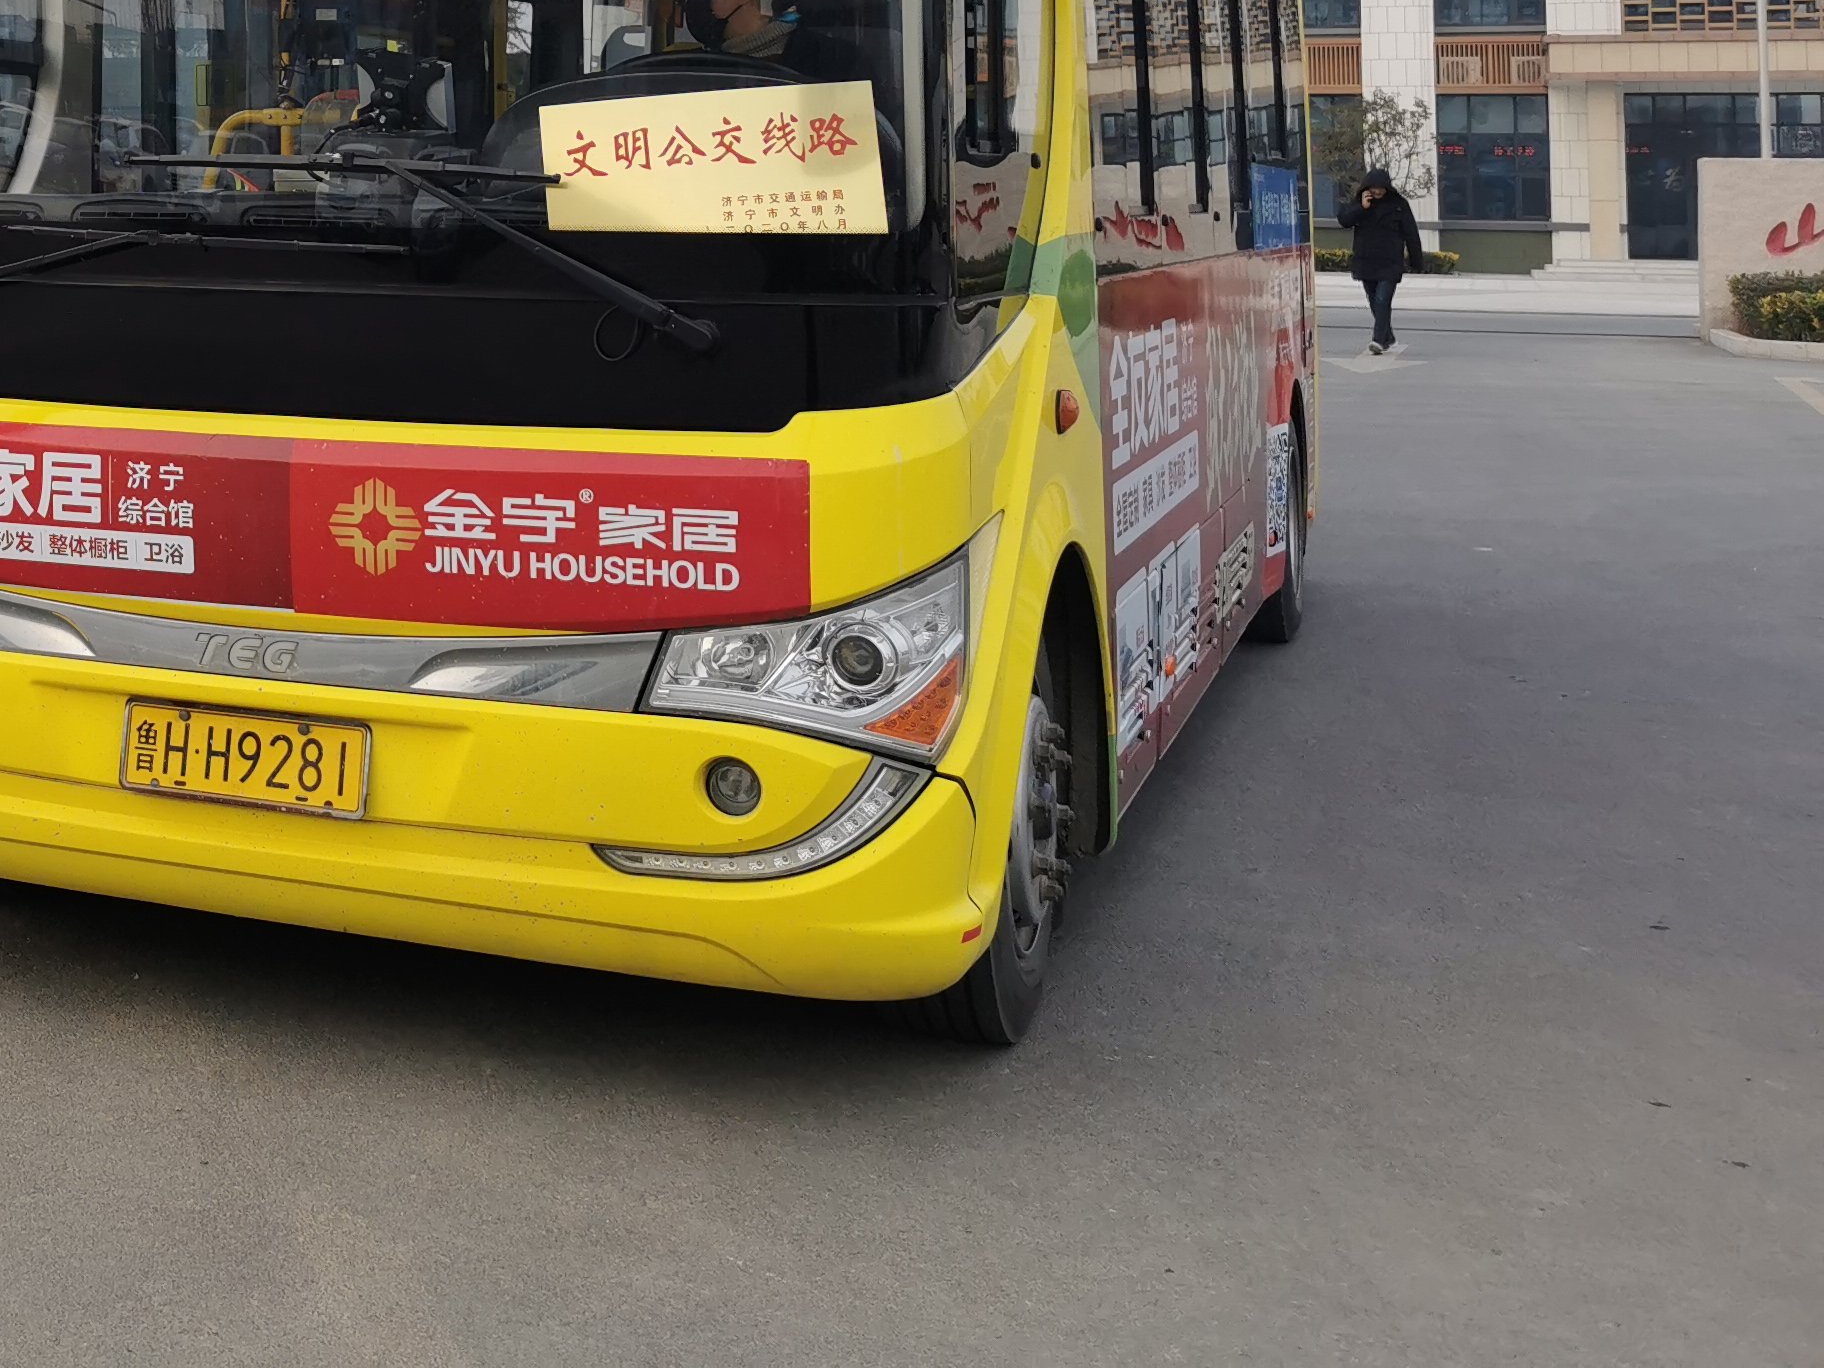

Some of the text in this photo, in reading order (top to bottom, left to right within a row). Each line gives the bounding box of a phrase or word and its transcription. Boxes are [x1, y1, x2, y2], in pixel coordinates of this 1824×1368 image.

[563, 111, 859, 177] 文明公交线路
[721, 189, 844, 207] 济宁市交通运输局
[722, 204, 846, 222] 济宁市文明办
[1109, 317, 1180, 470] 全友家居
[126, 461, 184, 490] 济宁
[118, 497, 194, 529] 综合馆
[48, 534, 129, 562] 整体橱柜
[143, 541, 184, 566] 卫浴
[424, 546, 741, 592] JINYU HOUSEHOLD
[195, 632, 300, 674] TEG
